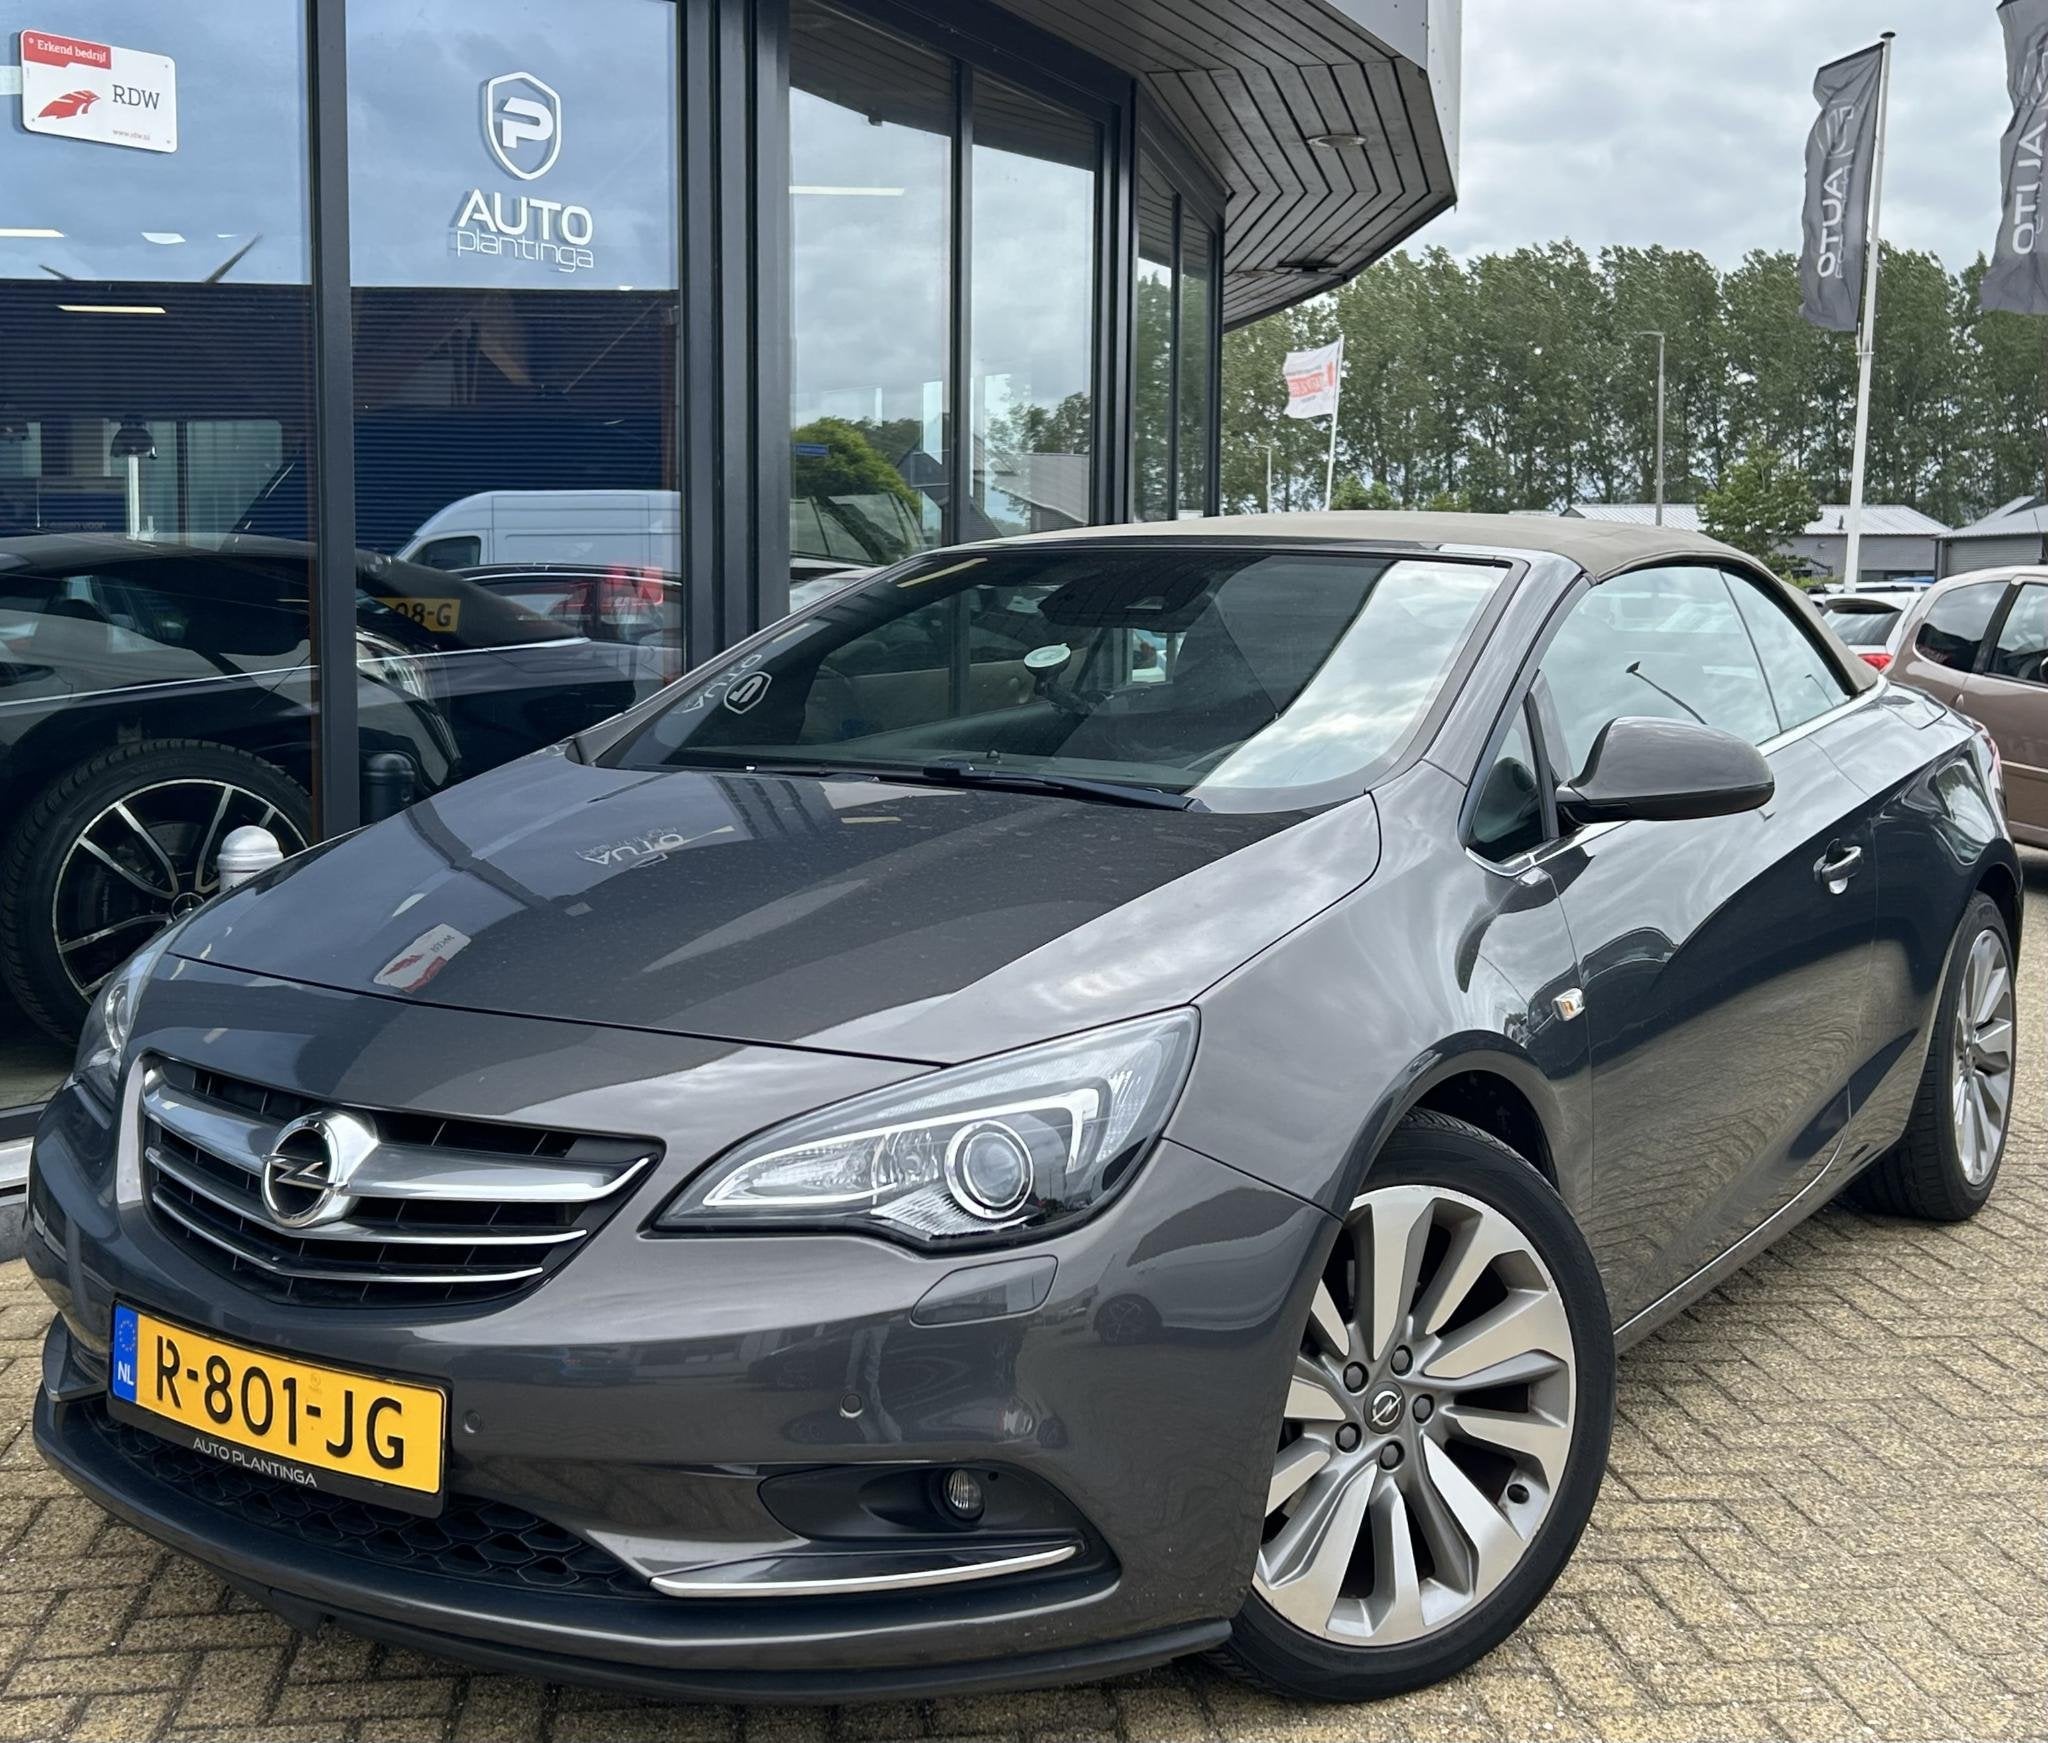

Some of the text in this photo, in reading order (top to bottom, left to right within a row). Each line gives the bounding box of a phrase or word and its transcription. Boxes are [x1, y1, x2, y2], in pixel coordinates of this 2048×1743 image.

[37, 39, 107, 63] Erkend bedrijf
[112, 84, 160, 110] RDW
[457, 188, 593, 246] AUTO
[456, 228, 594, 273] plantinga
[117, 1360, 134, 1387] NL
[156, 1335, 404, 1469] R-801-JG
[192, 1437, 317, 1487] AUTO PLANTINGA
